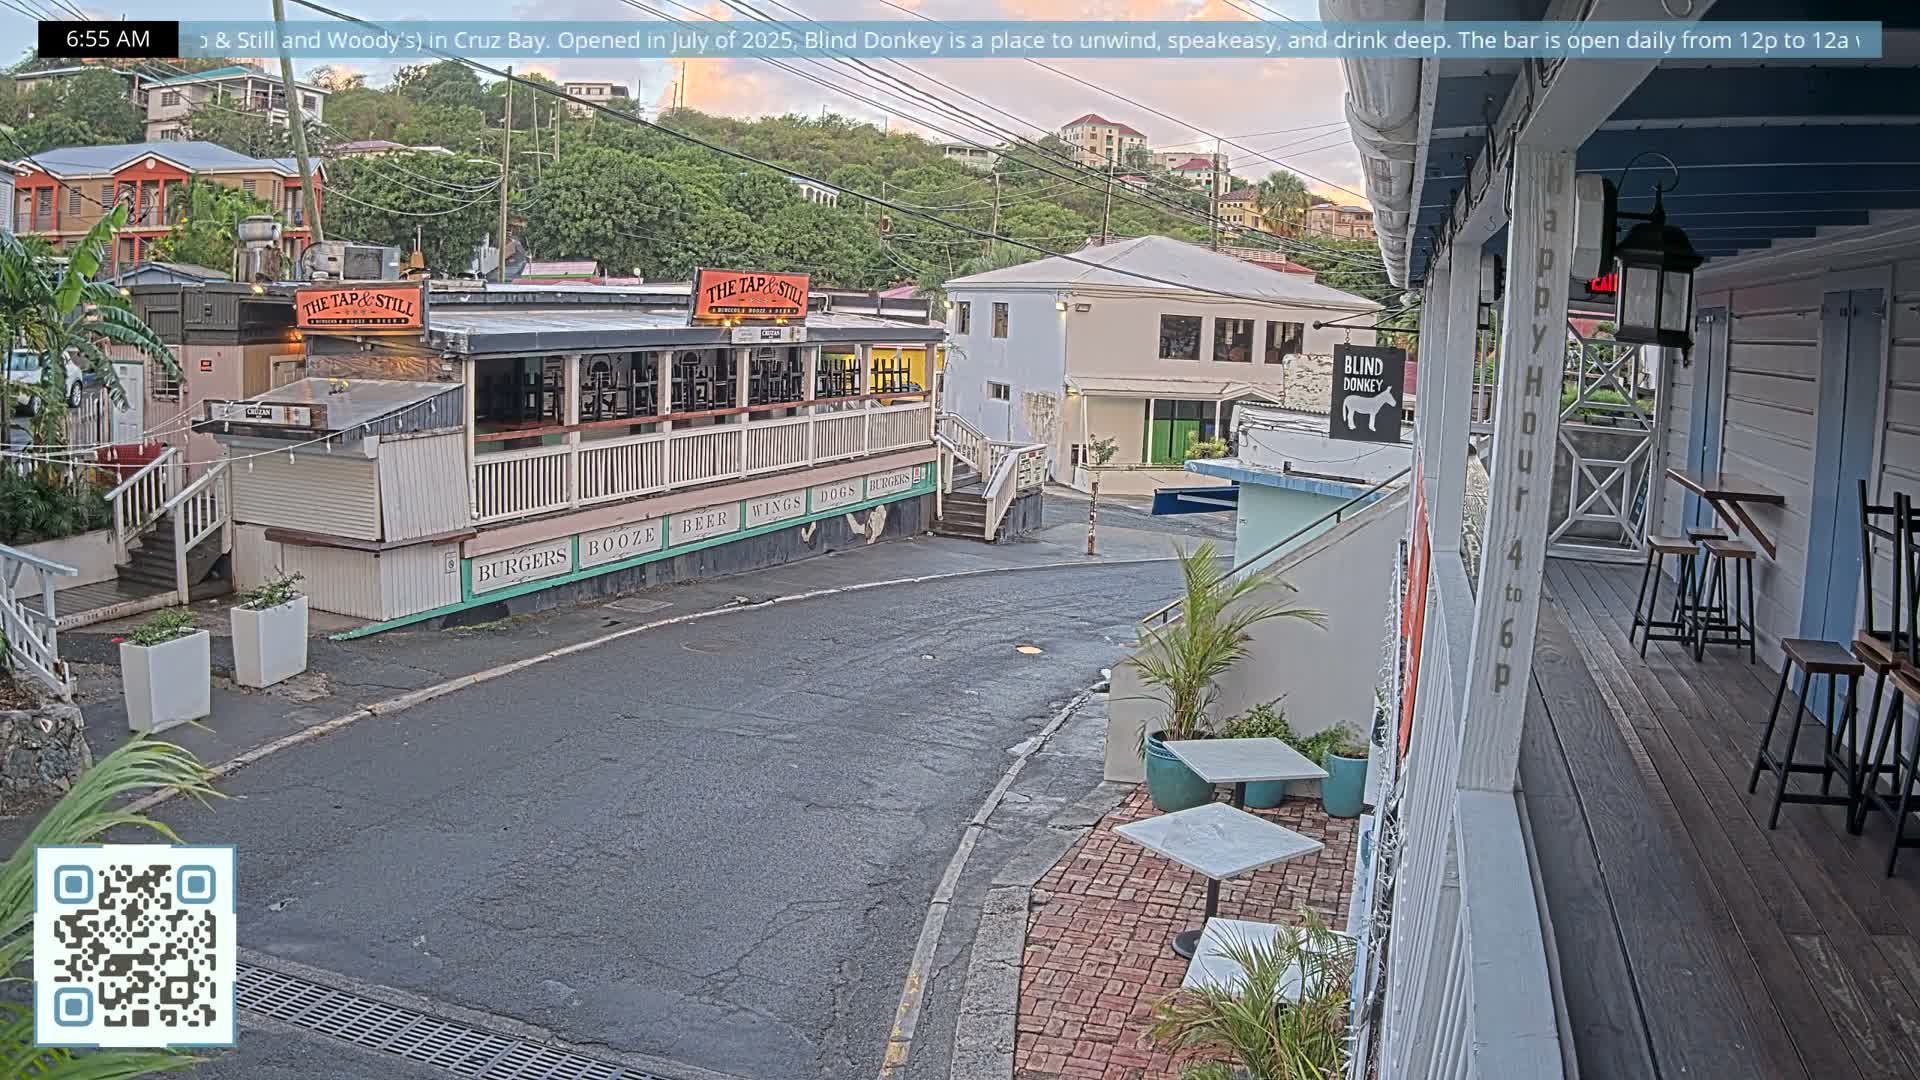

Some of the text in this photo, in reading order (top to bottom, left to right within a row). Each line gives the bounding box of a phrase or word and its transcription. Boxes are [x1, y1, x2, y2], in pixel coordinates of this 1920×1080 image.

[1533, 163, 1563, 354] Happy
[706, 276, 803, 307] THE TAP & STILL
[303, 291, 414, 317] THE TAP & STILL
[1344, 355, 1383, 375] BLIND
[1343, 377, 1383, 392] DONKEY
[1516, 365, 1543, 512] Hour
[821, 484, 856, 504] DOGS
[869, 472, 911, 492] BURGERS
[752, 496, 801, 517] WINGS
[683, 511, 728, 534] BEER
[589, 527, 655, 556] BOOZE
[479, 548, 567, 582] BURGERS
[1507, 540, 1522, 571] 4
[1505, 584, 1522, 602] to
